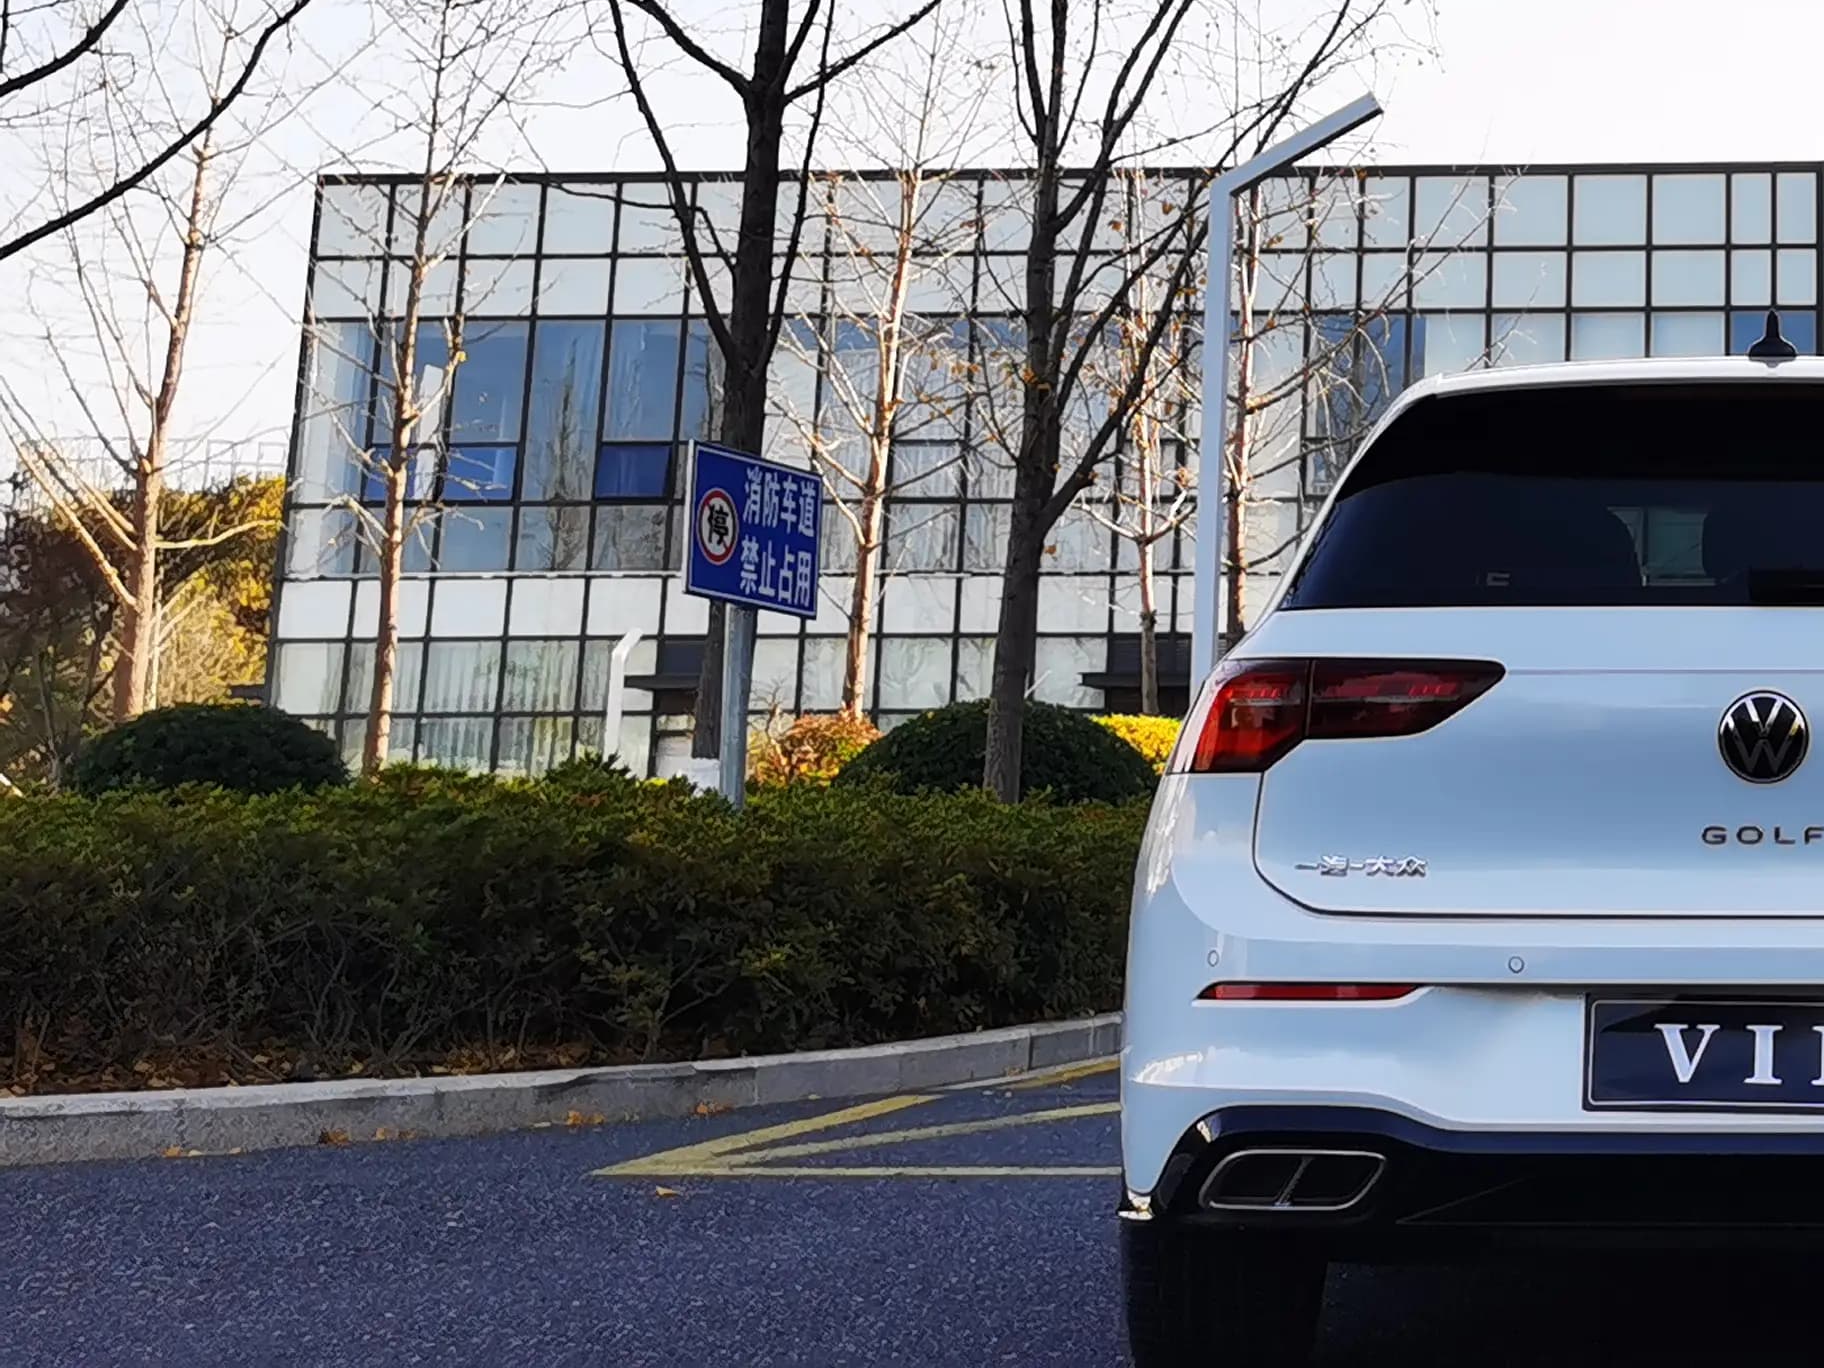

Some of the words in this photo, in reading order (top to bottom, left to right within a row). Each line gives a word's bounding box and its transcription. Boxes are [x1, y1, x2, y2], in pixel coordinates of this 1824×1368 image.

[742, 466, 816, 538] 消防车道
[739, 534, 813, 607] 禁止占用
